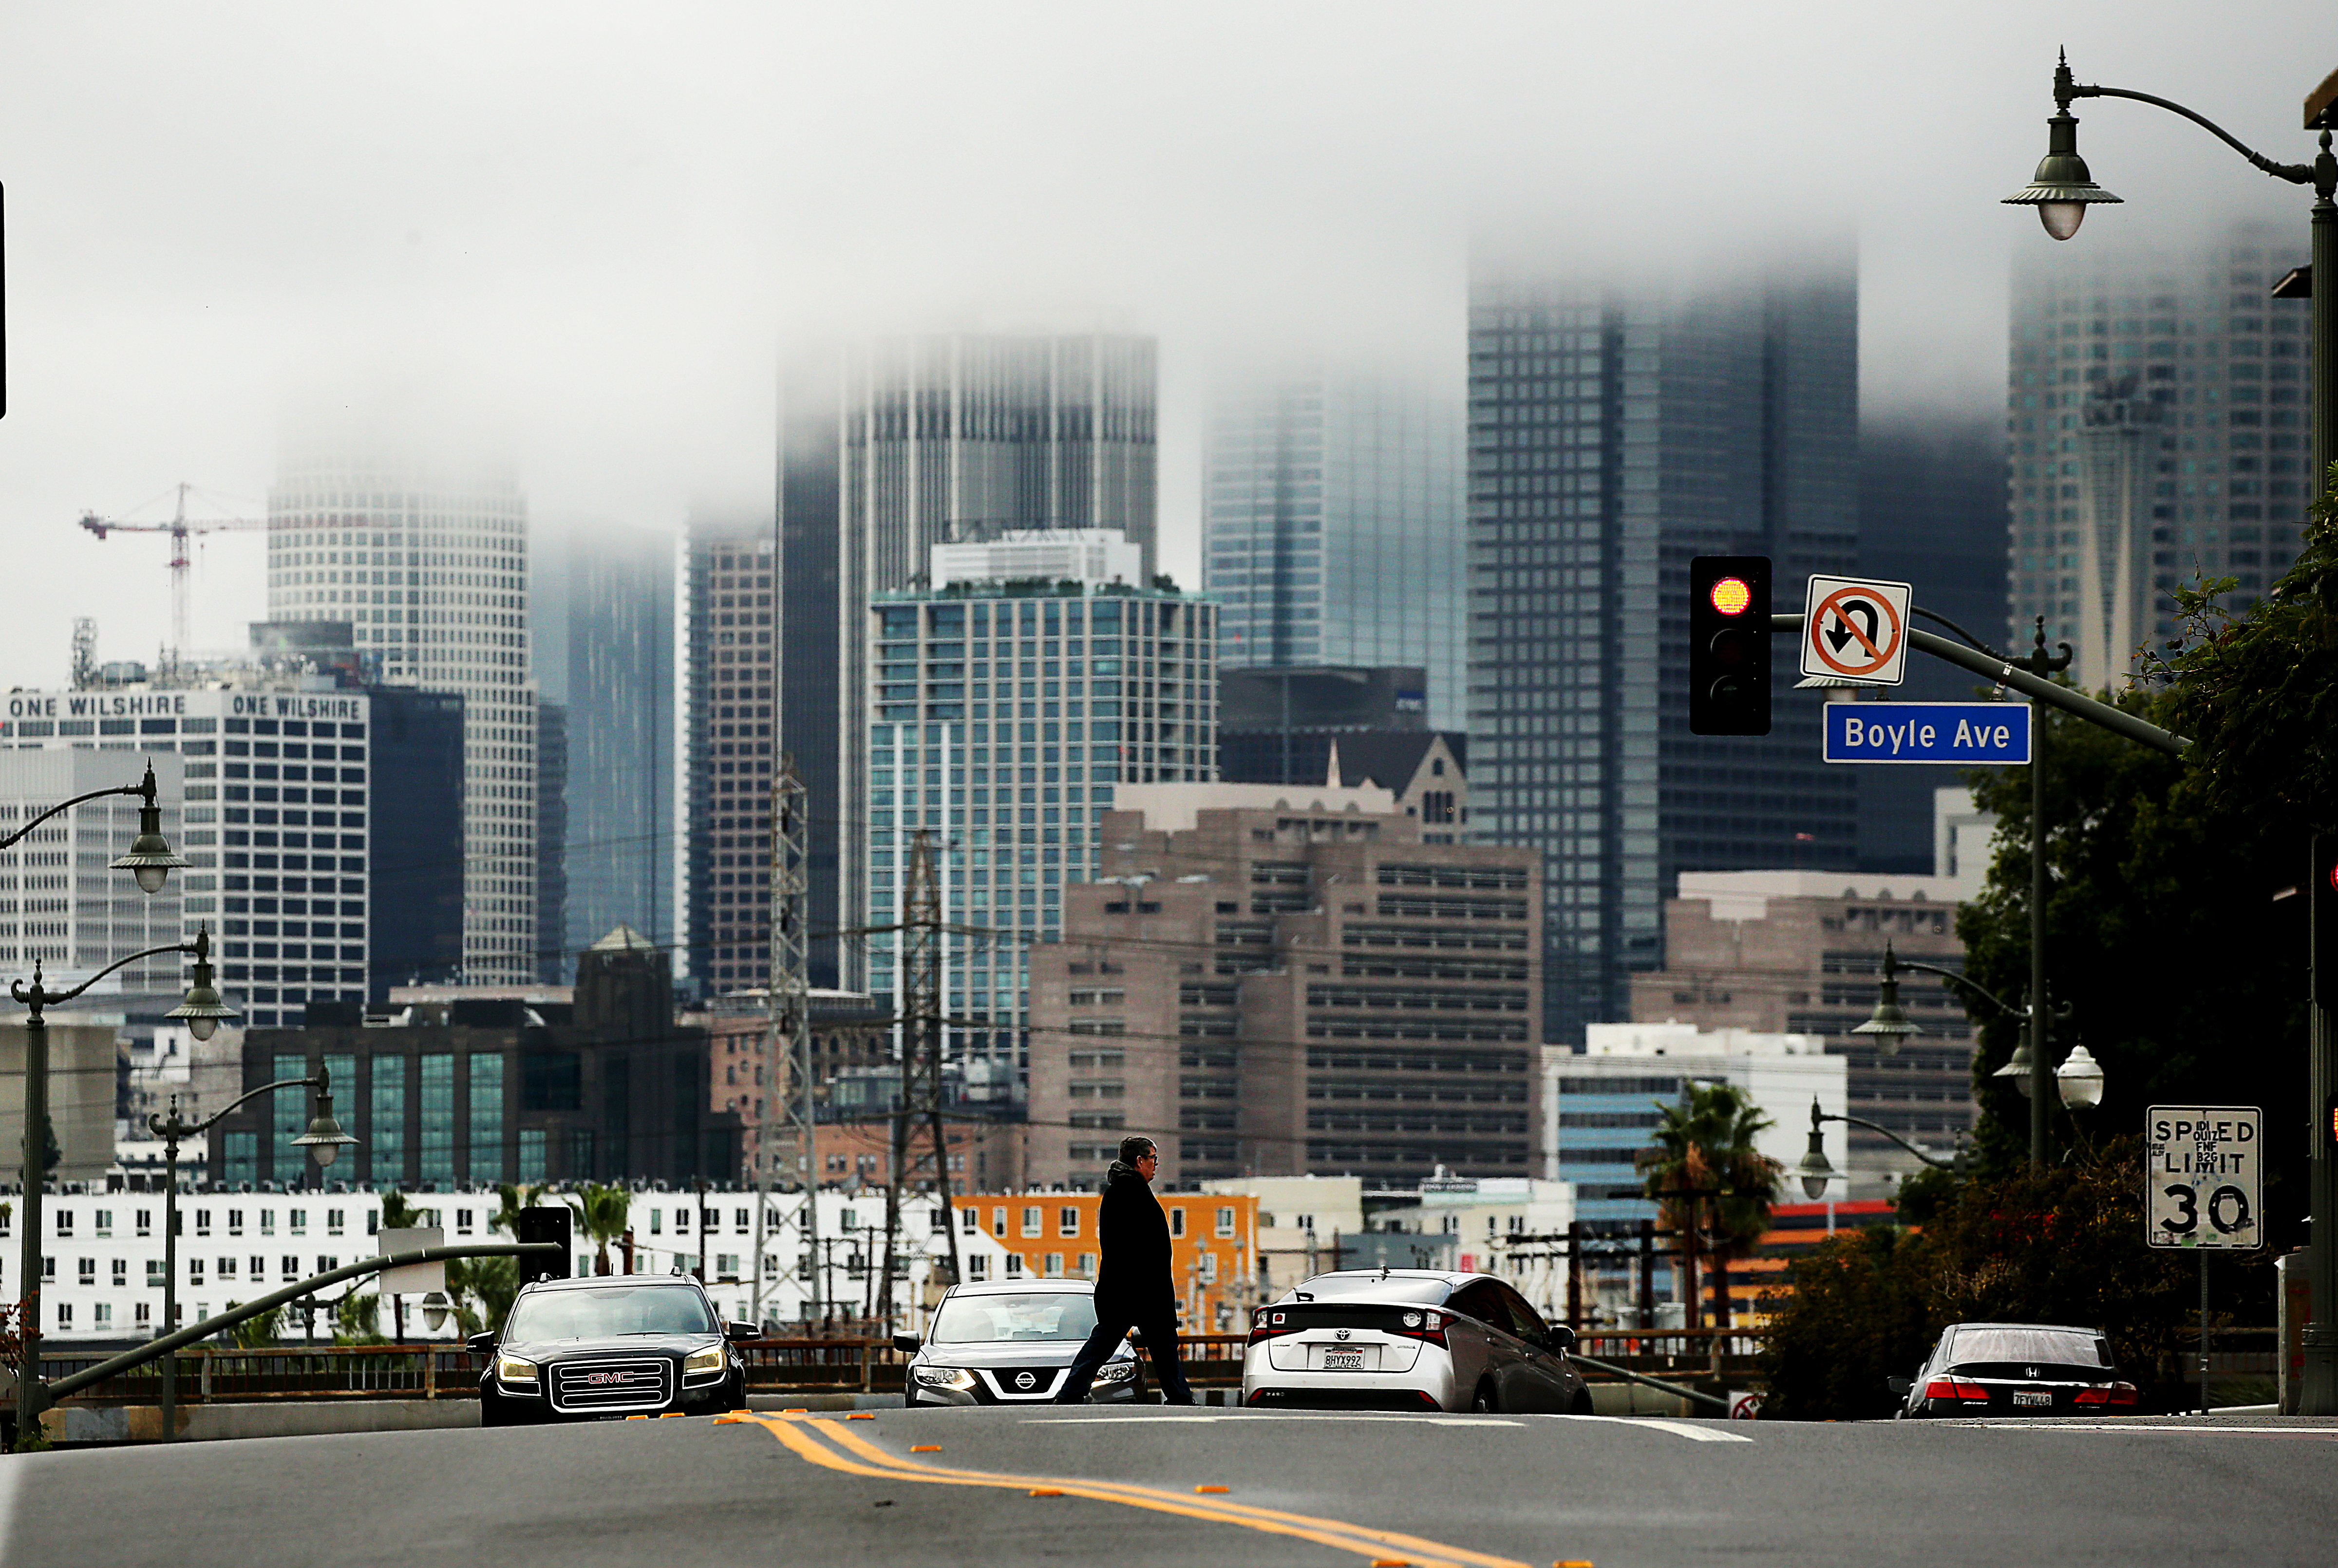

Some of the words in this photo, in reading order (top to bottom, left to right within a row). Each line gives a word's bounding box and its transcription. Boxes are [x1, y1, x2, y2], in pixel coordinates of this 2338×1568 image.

[10, 698, 56, 716] ONE
[68, 695, 185, 715] WILSHIRE
[233, 695, 267, 715] ONE
[276, 697, 358, 719] WILSHIRE
[1846, 718, 1936, 754] Boyle
[1953, 719, 2010, 748] Ave
[2197, 1152, 2218, 1162] B2G
[2160, 1184, 2249, 1234] 30
[1326, 1355, 1361, 1365] 8HYX992
[588, 1371, 634, 1384] GMC
